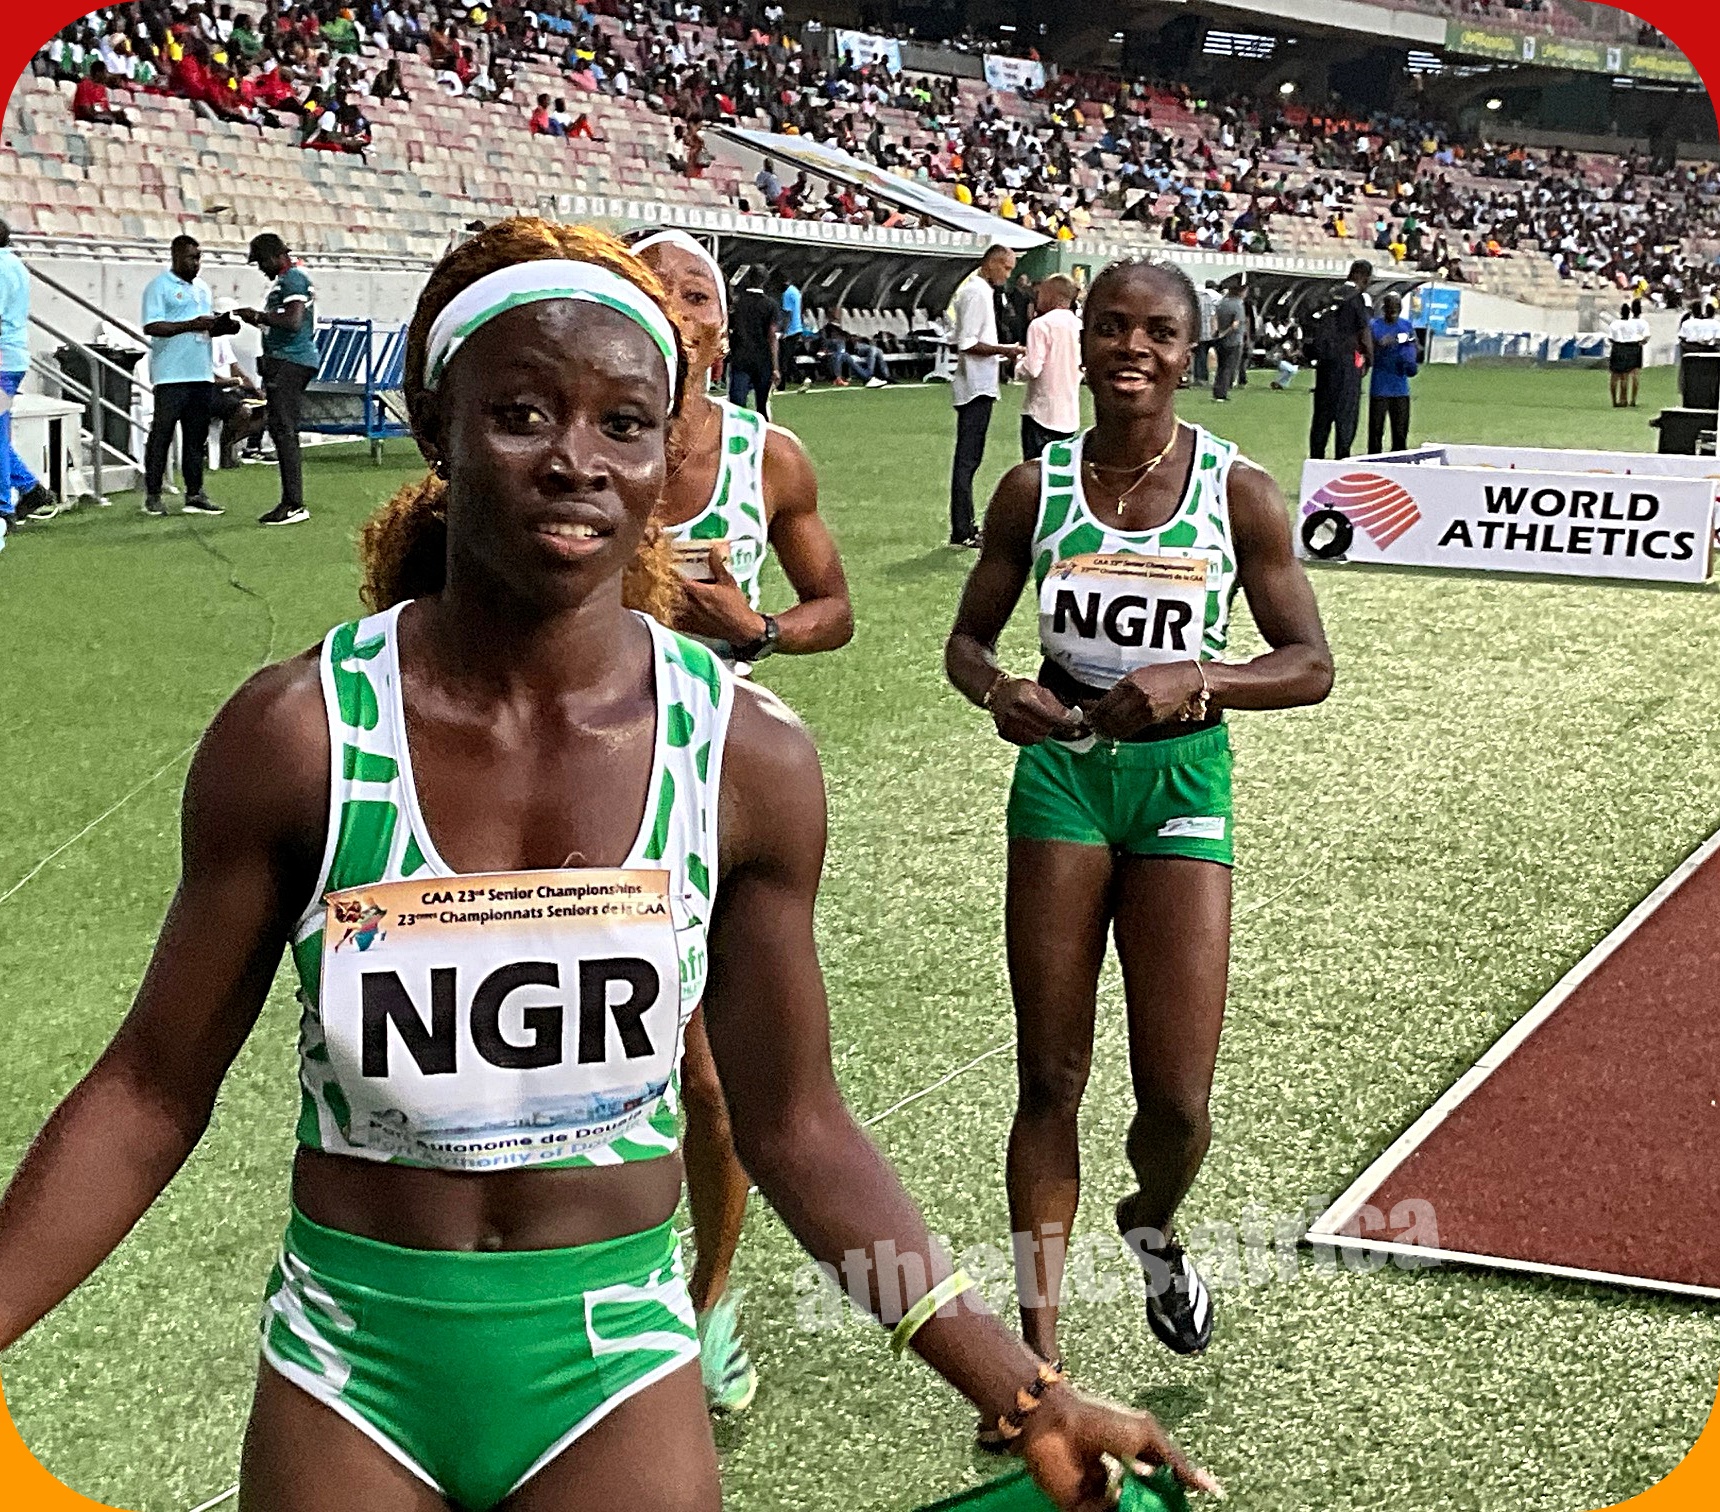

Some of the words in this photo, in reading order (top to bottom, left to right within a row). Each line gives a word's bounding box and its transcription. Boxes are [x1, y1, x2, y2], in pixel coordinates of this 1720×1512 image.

[1484, 485, 1660, 522] WORLD
[1437, 519, 1695, 561] ATHLETICS
[1053, 589, 1193, 651] NGR
[421, 891, 454, 906] CAA
[488, 887, 534, 902] Senior
[536, 883, 643, 902] Championships
[439, 907, 543, 926] Championnats
[547, 902, 599, 919] Seniors
[601, 902, 619, 915] de
[635, 902, 667, 916] CAA
[361, 956, 661, 1079] NGR
[540, 1132, 568, 1145] de
